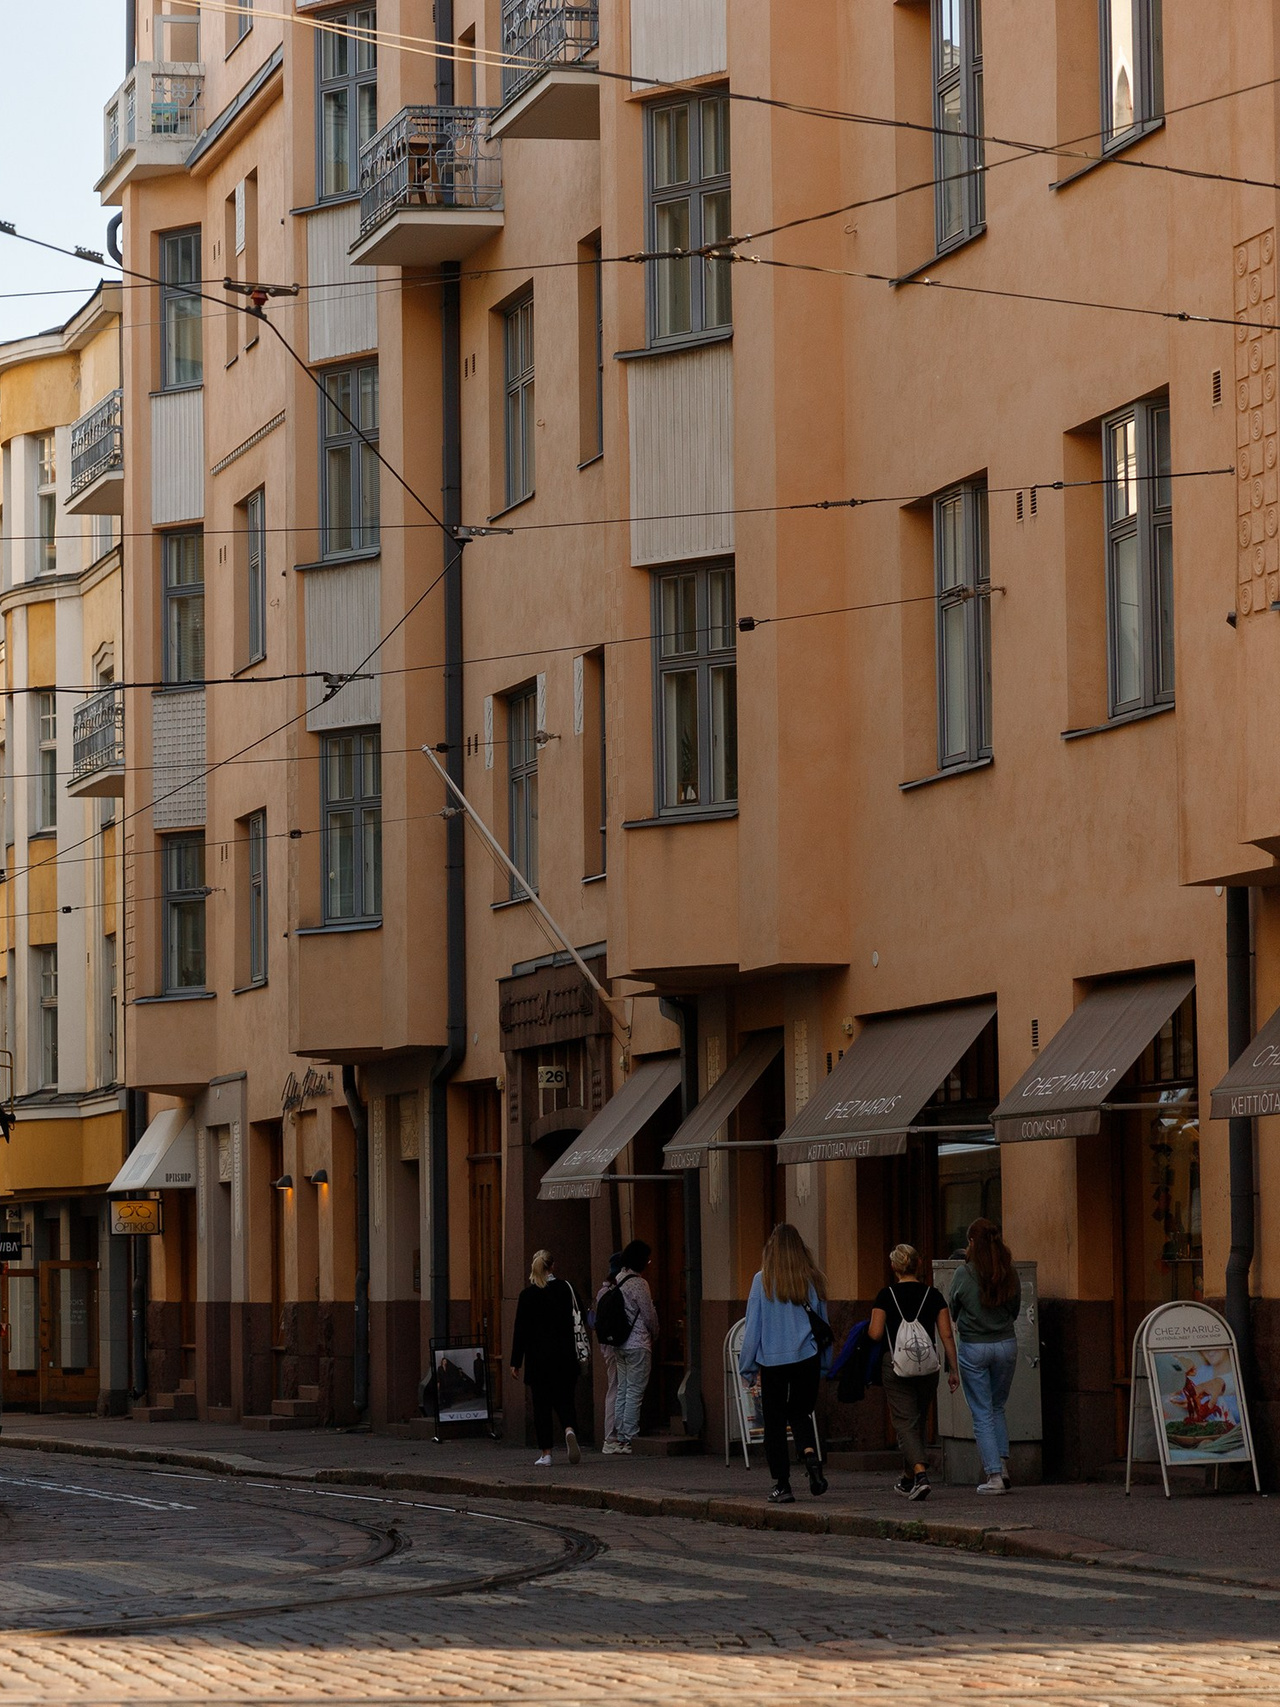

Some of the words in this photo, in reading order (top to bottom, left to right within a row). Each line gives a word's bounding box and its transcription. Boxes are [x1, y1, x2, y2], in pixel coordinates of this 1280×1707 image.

[545, 1071, 564, 1083] 26
[8, 1209, 18, 1218] 24
[115, 1221, 156, 1232] OPTIKKO
[1154, 1327, 1180, 1336] CHEZ
[1183, 1324, 1221, 1334] MARIUS
